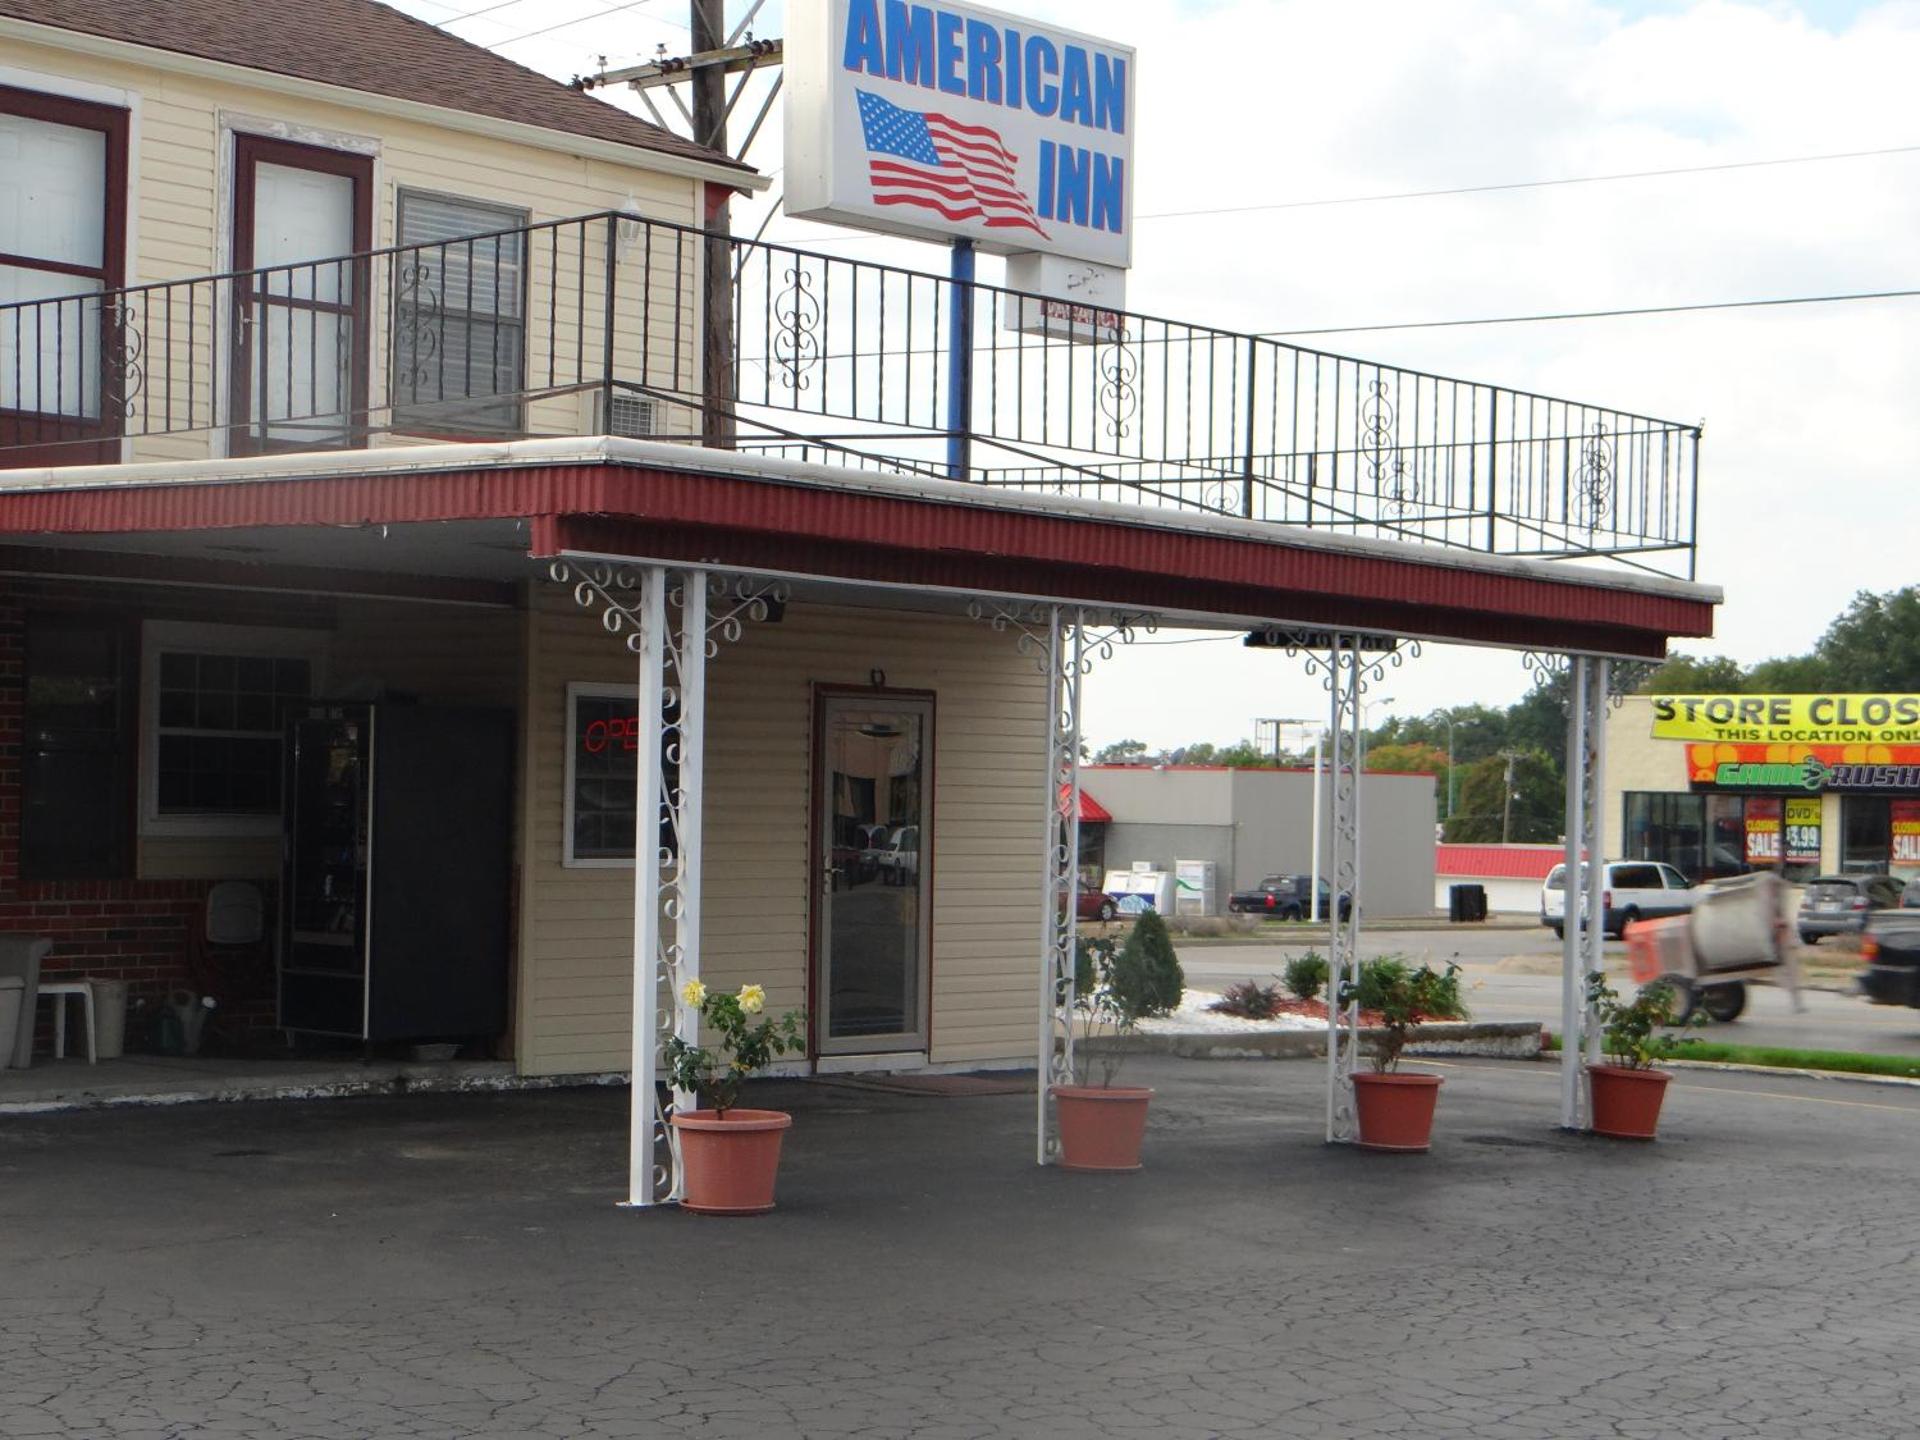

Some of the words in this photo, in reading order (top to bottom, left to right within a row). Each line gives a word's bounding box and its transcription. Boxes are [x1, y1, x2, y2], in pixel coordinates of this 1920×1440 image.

[843, 0, 1126, 135] AMERICAN
[1037, 138, 1124, 235] INN
[1654, 697, 1792, 726] STORE
[584, 717, 639, 753] OPE
[1715, 728, 1760, 741] THIS
[1768, 729, 1872, 742] LOCATION
[1828, 764, 1920, 787] RUSH
[1747, 832, 1780, 858] SALE
[1893, 835, 1920, 861] SAL
